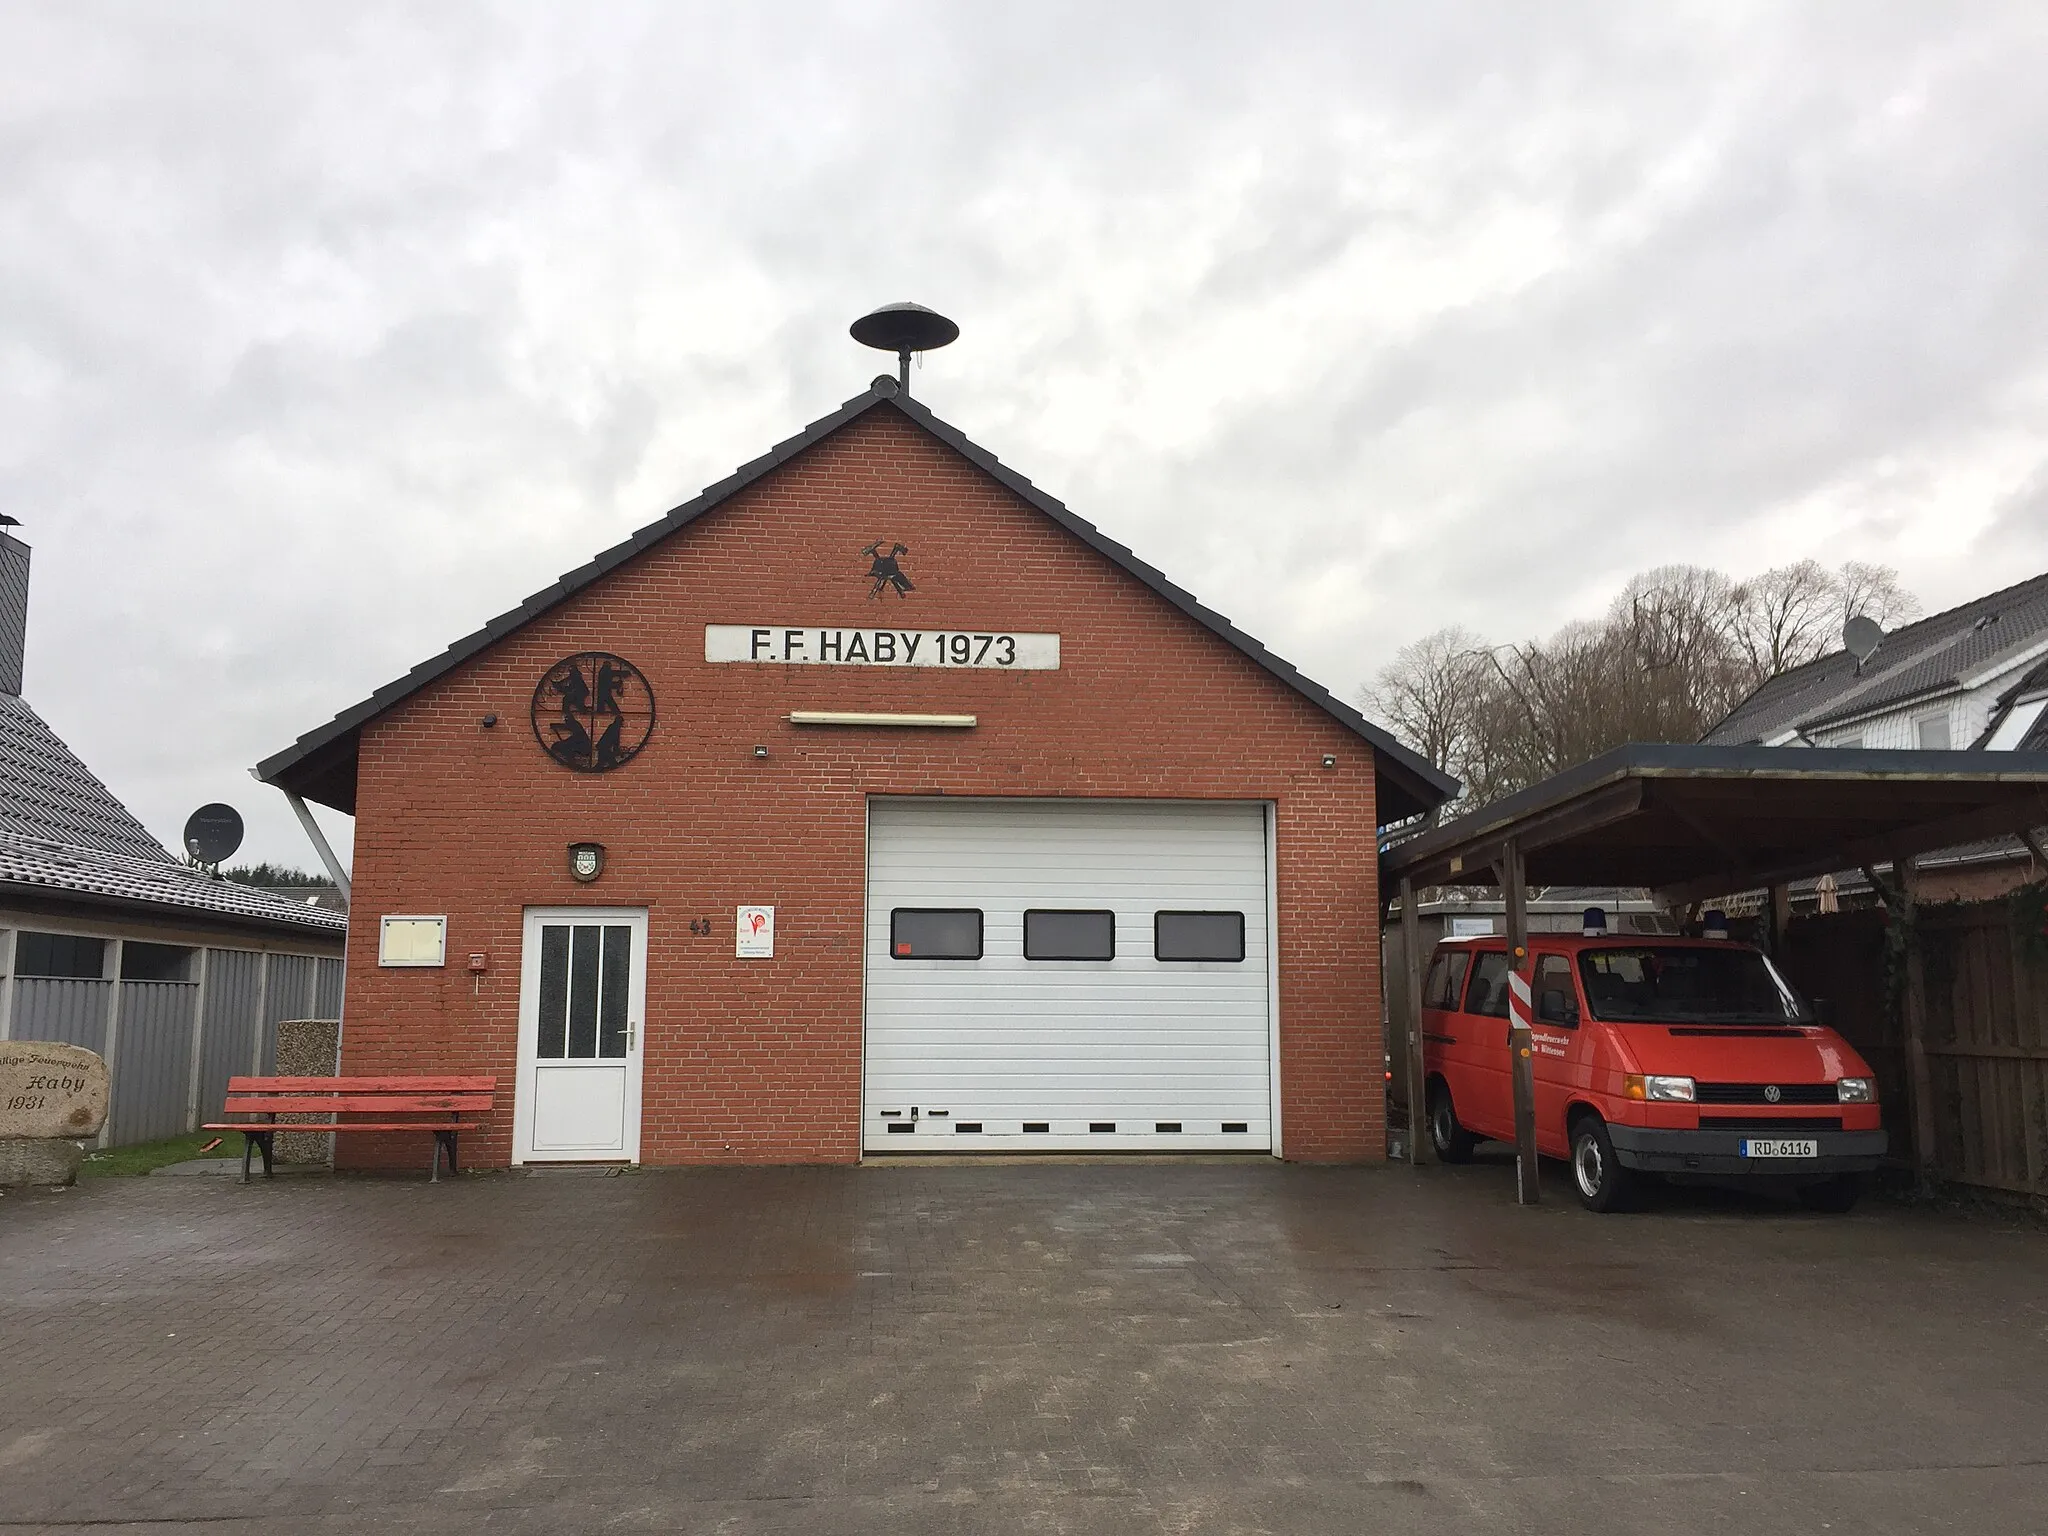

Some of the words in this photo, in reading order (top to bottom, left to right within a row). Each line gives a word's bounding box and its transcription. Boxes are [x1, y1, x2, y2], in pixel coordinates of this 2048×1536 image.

[820, 630, 923, 664] HABY
[935, 634, 1017, 666] 1973
[690, 918, 711, 935] 43
[28, 1054, 90, 1072] Feuerwehr
[26, 1075, 86, 1093] Haby
[7, 1095, 46, 1110] 1931
[1754, 1142, 1772, 1156] RD
[1780, 1142, 1811, 1156] 6116
